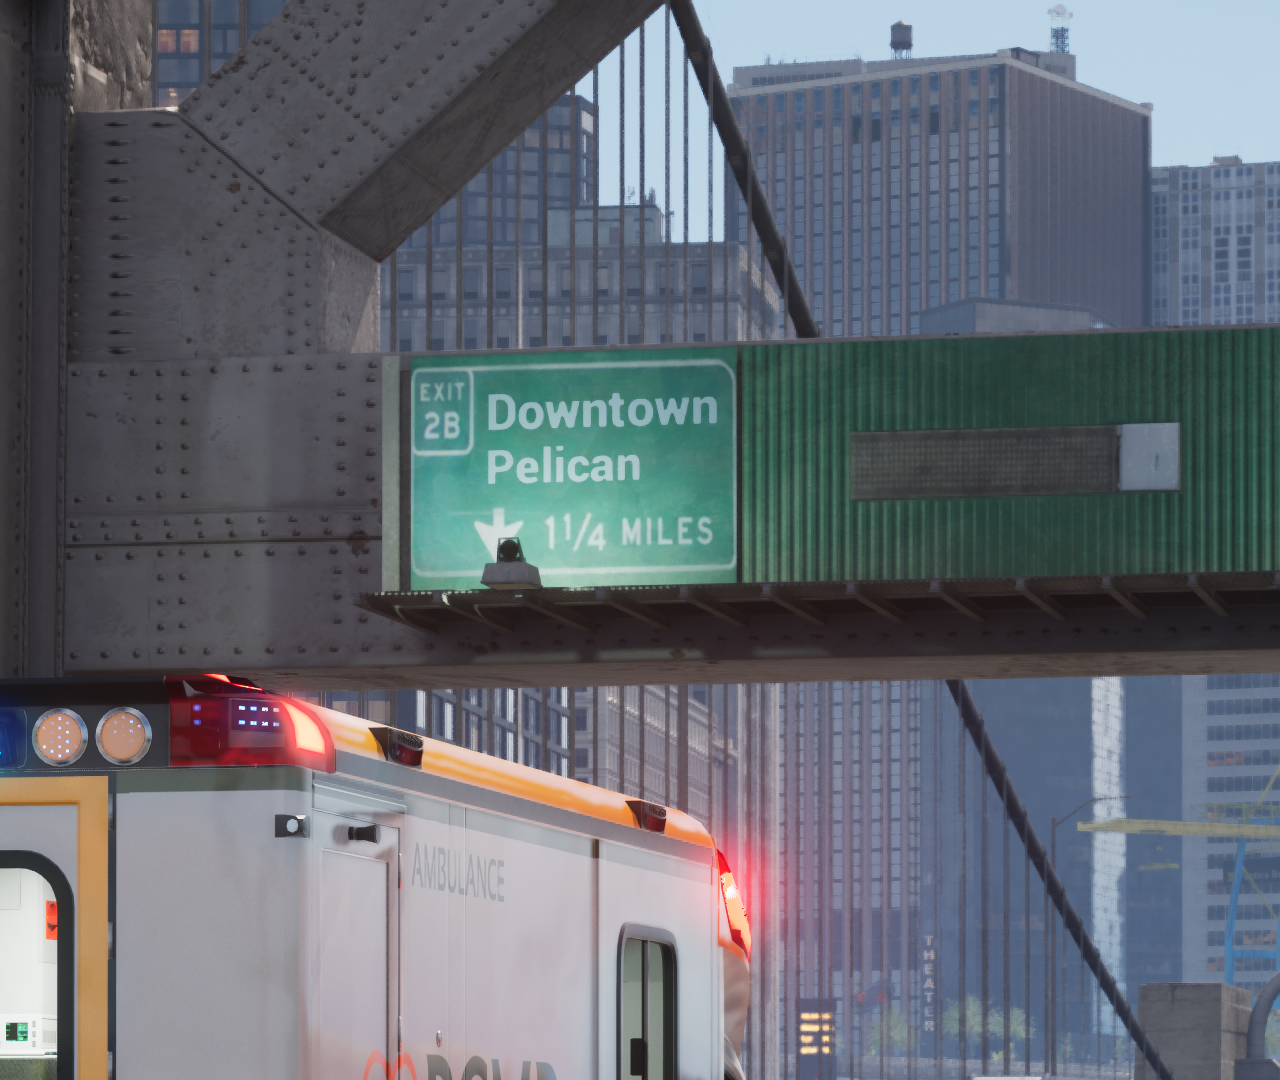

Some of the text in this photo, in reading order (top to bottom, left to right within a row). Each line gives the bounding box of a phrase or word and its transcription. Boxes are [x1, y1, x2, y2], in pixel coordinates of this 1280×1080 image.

[421, 382, 465, 402] EXIT
[424, 412, 461, 440] 2B
[488, 392, 718, 431] Downtown
[488, 446, 641, 484] Pelican
[622, 516, 714, 546] MILES
[411, 842, 505, 902] AMBULANCE
[923, 935, 936, 1032] THEATER
